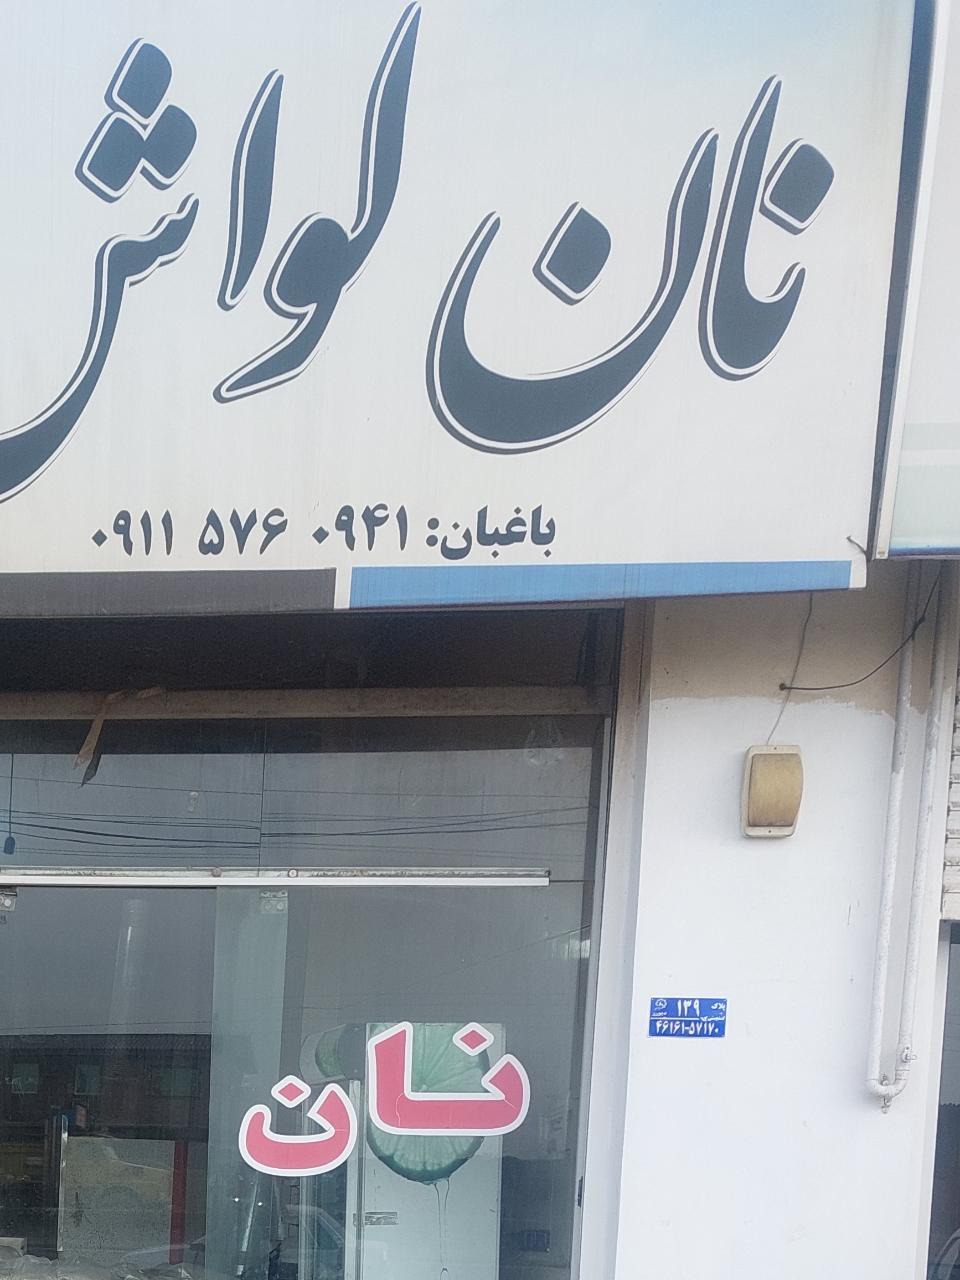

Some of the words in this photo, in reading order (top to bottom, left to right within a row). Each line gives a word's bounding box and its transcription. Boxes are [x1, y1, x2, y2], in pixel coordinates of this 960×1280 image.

[426, 74, 835, 454] نان
[92, 508, 174, 555] ۰۹۱۱
[197, 508, 288, 555] ۵۷۶
[311, 504, 409, 551] ۰۹۴۱
[677, 999, 700, 1017] ۱۳۹
[238, 1021, 531, 1176] نان
